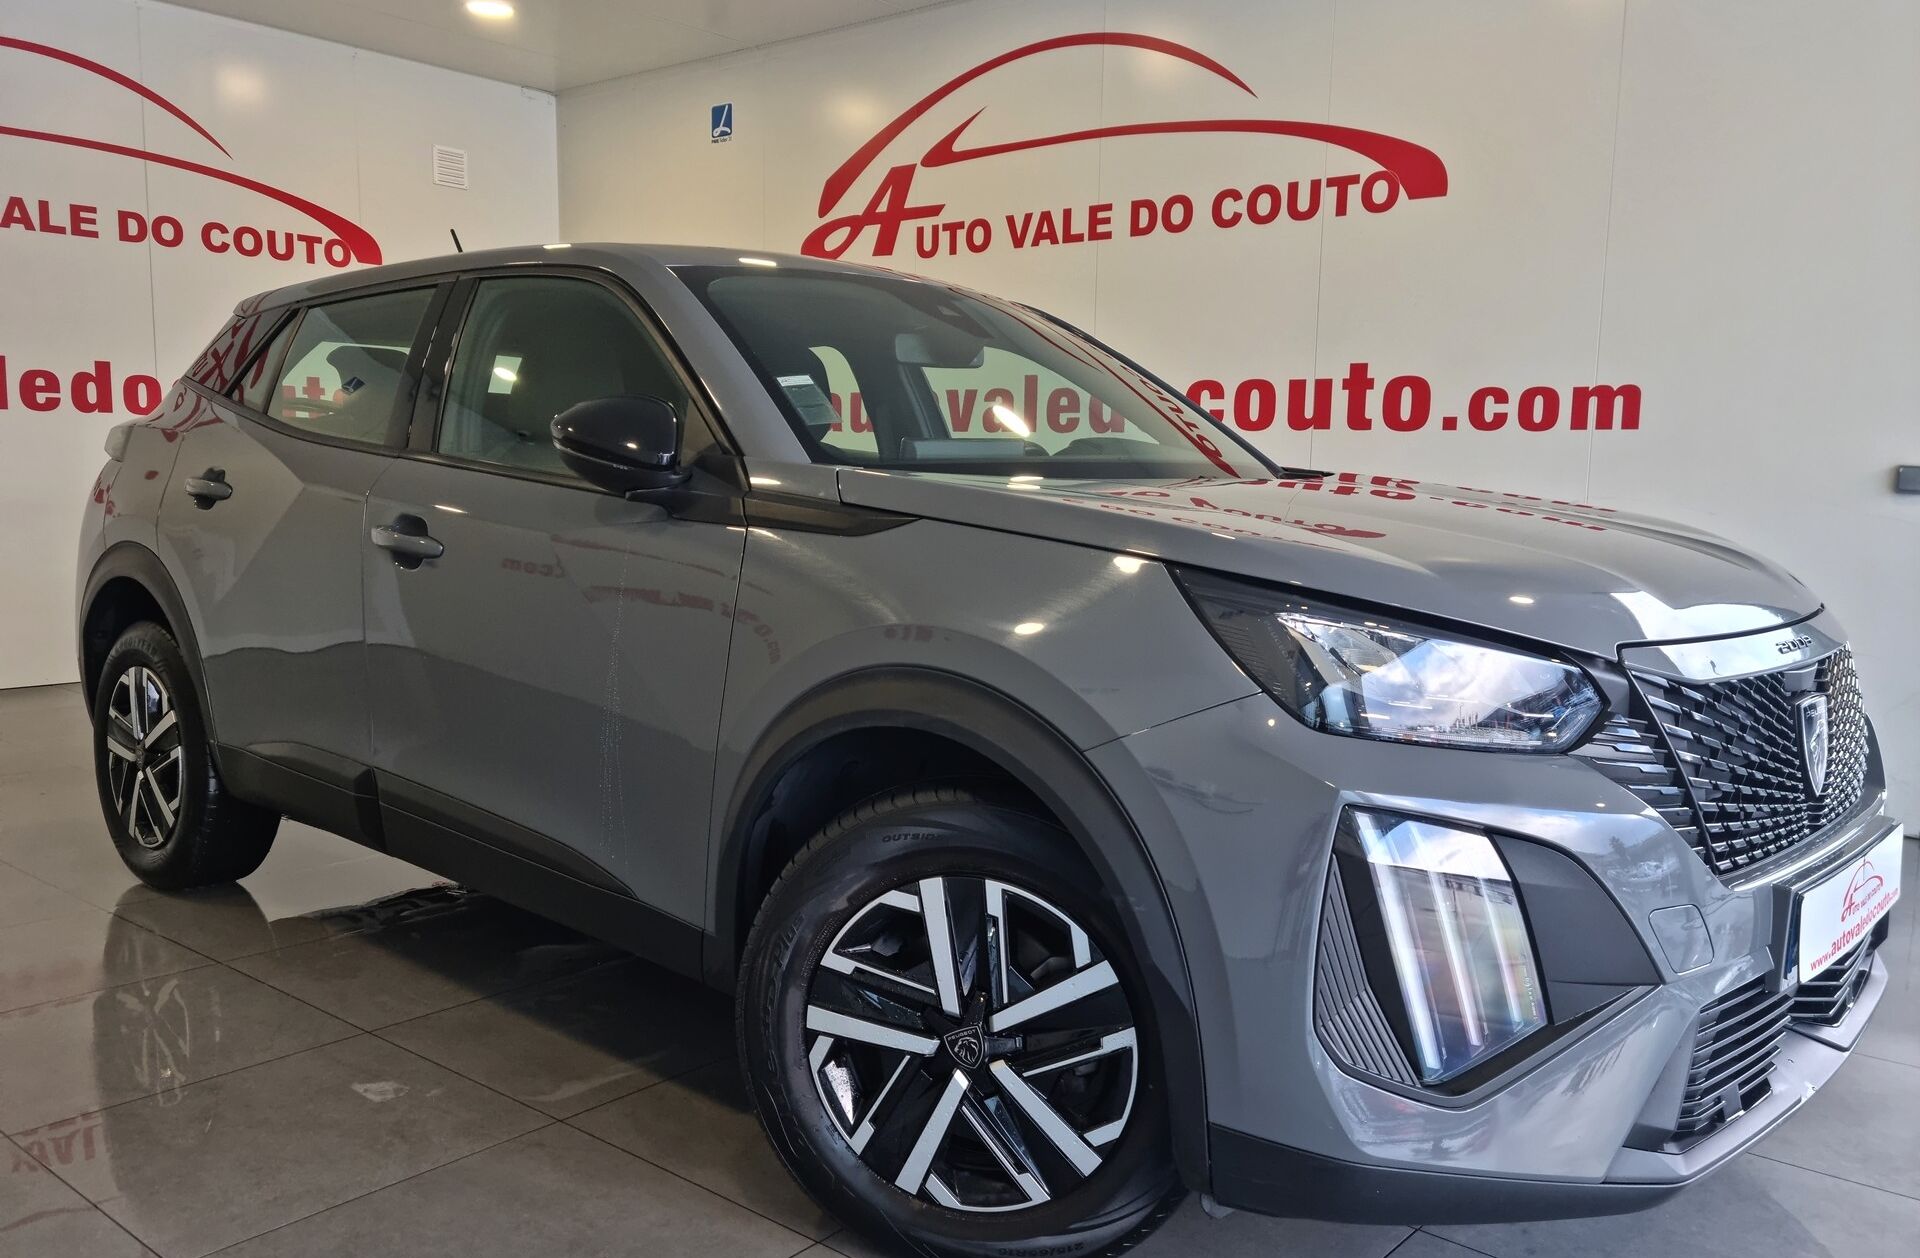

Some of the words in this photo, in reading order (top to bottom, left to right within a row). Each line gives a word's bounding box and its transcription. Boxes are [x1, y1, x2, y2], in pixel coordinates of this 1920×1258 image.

[1005, 203, 1113, 249] VALE
[1130, 194, 1194, 238] DO
[1211, 170, 1400, 229] COUTO
[117, 210, 184, 248] DO
[201, 222, 352, 268] COUTO
[947, 1029, 977, 1041] PEUGEOT
